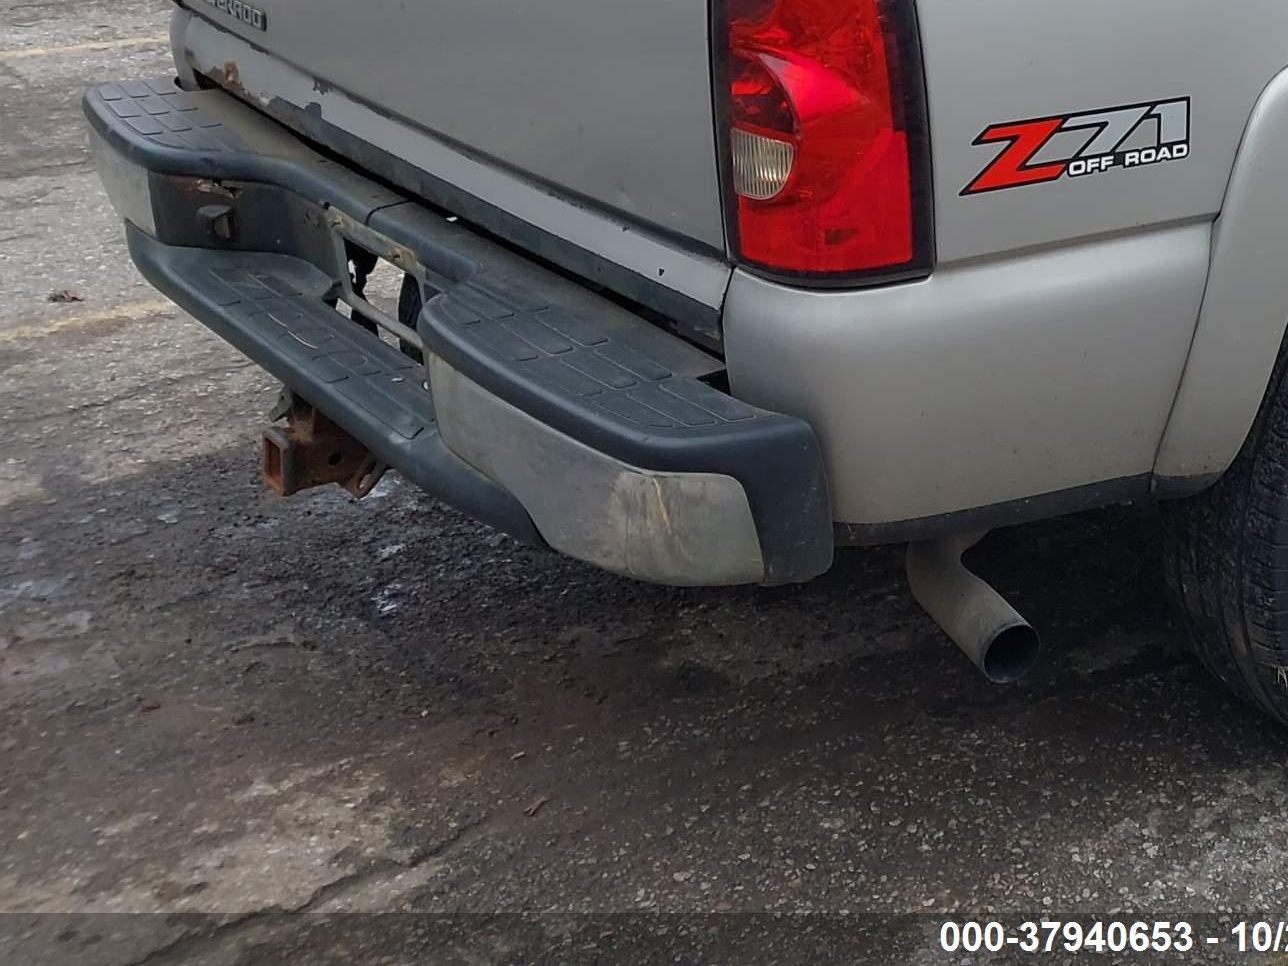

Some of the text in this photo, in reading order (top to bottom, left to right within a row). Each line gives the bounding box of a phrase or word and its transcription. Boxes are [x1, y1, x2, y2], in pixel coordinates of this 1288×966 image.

[959, 95, 1190, 196] Z71
[1068, 143, 1188, 176] OFF ROAD
